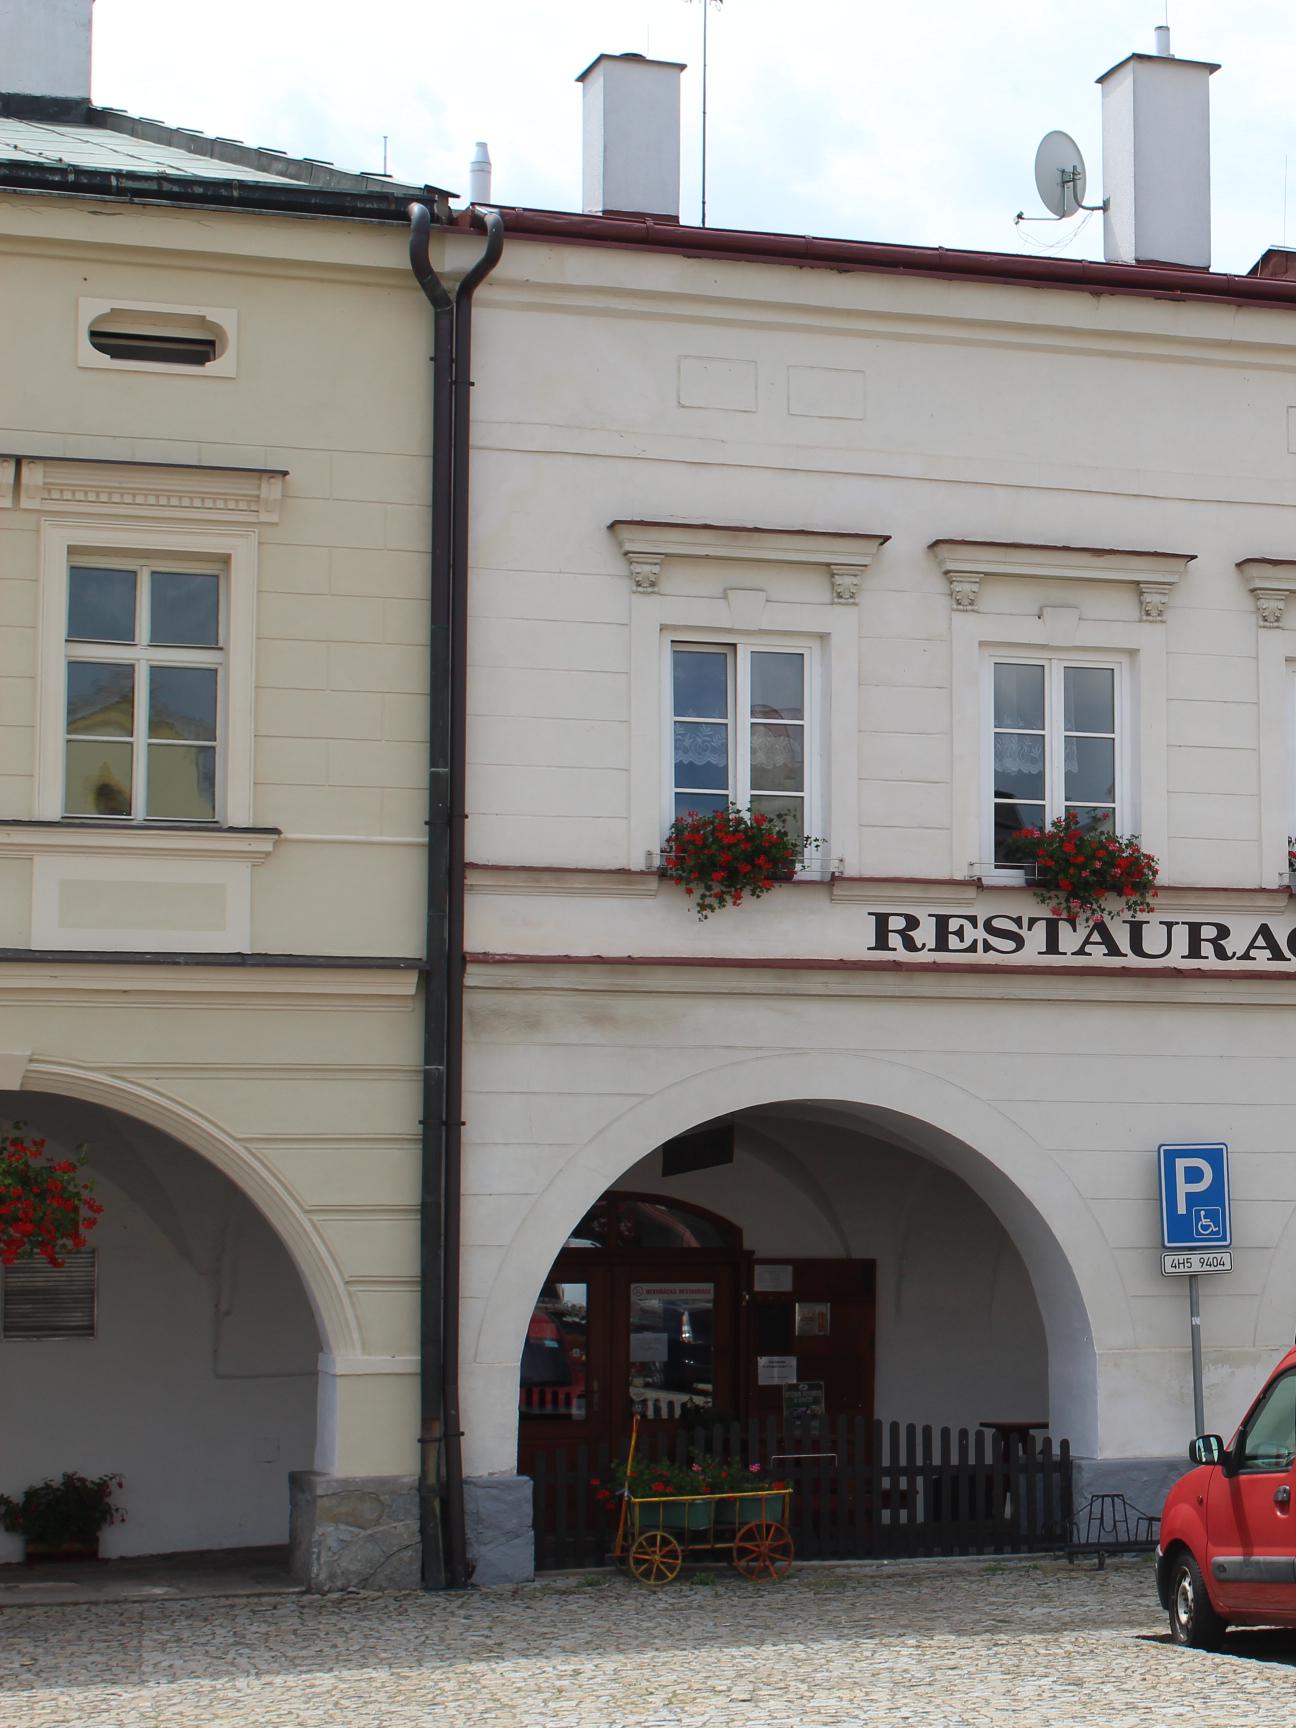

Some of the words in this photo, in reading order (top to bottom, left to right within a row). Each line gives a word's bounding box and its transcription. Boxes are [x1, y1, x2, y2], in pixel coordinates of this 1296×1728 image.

[1175, 1157, 1213, 1215] P
[1170, 1257, 1193, 1270] 4H5
[1198, 1256, 1226, 1269] 9404
